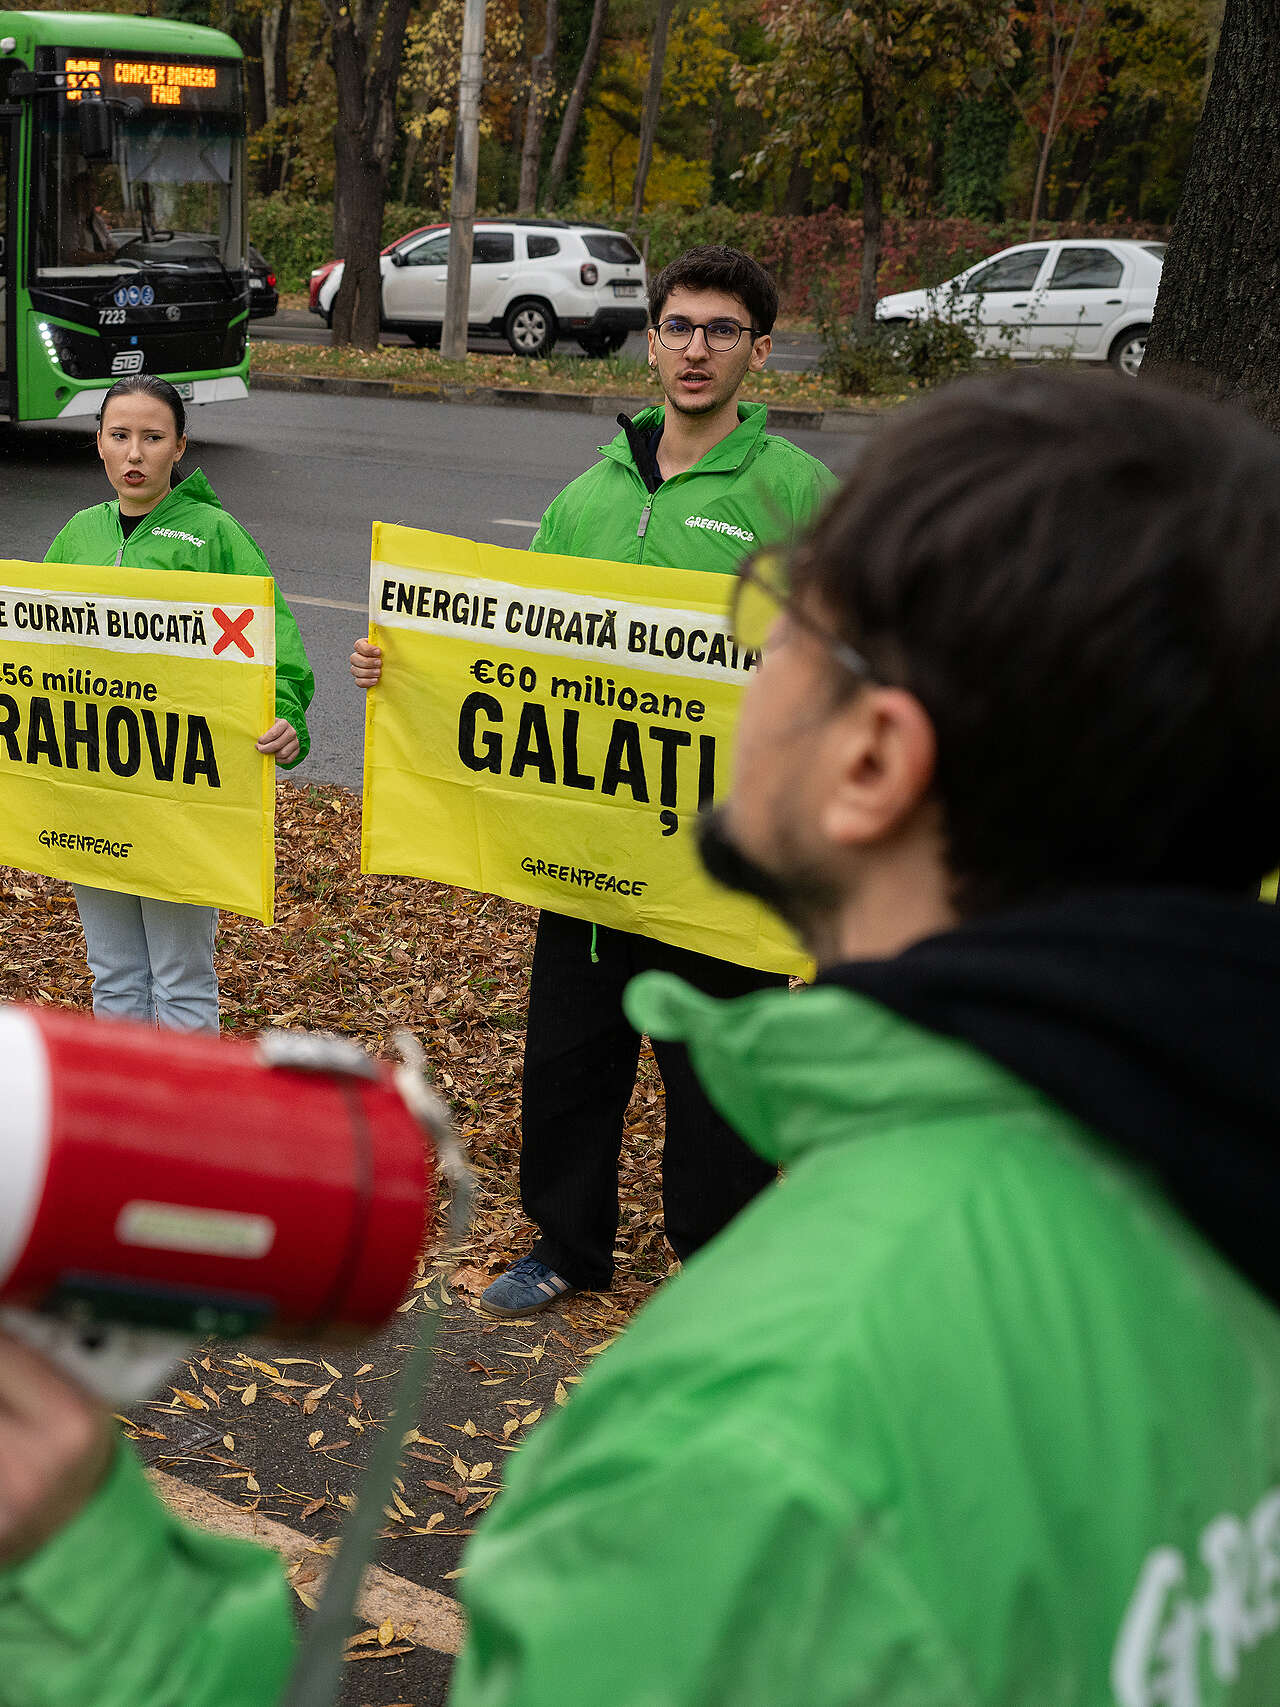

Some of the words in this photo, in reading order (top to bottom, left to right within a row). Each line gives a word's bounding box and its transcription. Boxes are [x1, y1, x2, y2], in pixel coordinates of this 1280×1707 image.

[114, 62, 166, 84] COMPLEX
[151, 84, 181, 104] FAUR
[98, 309, 127, 325] 7223
[111, 353, 142, 372] STB
[684, 515, 755, 542] GREENPEACE
[14, 602, 100, 636] CURATĂ
[106, 609, 207, 646] BLOCATĂ
[381, 579, 498, 630] ENERGIE
[505, 601, 618, 650] CURATĂ
[42, 667, 158, 702] milioane
[470, 659, 537, 693] €60
[551, 674, 706, 722] milioane
[457, 691, 716, 837] GALAȚI
[38, 829, 133, 858] GREENPEACE
[520, 856, 648, 896] GREENPEACE
